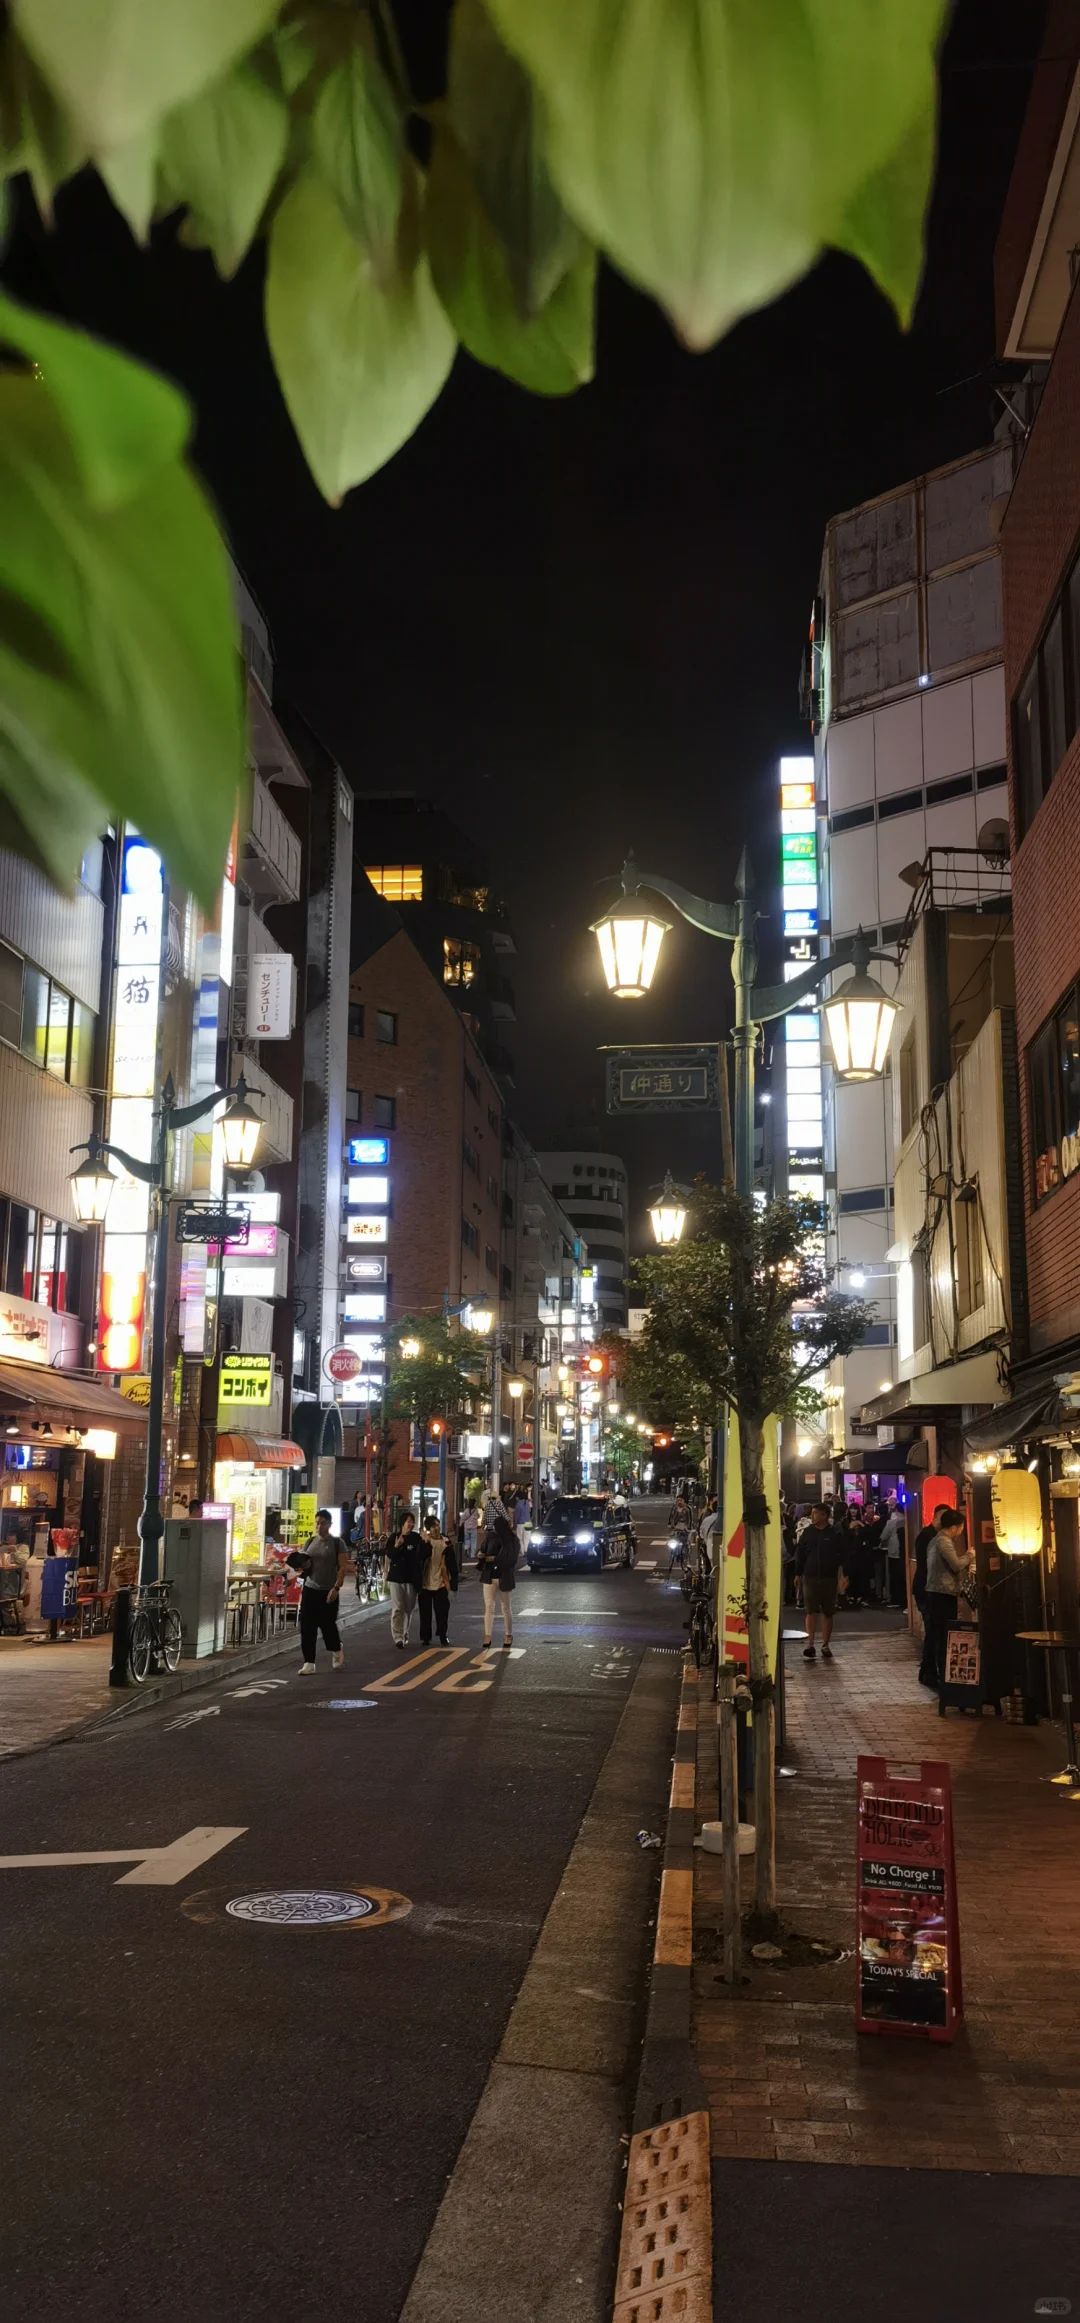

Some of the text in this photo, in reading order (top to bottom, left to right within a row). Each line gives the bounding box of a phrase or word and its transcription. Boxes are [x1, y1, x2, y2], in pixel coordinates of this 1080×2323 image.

[260, 972, 271, 1022] センチュリー
[630, 1074, 693, 1094] 仲通り
[332, 1358, 359, 1371] 消火栓
[223, 1378, 268, 1398] コンボイ
[862, 1797, 943, 1826] DIAMOND
[870, 1863, 887, 1875] No
[889, 1866, 929, 1881] Charge
[869, 1965, 938, 1981] TODAY'S SPECIAL
